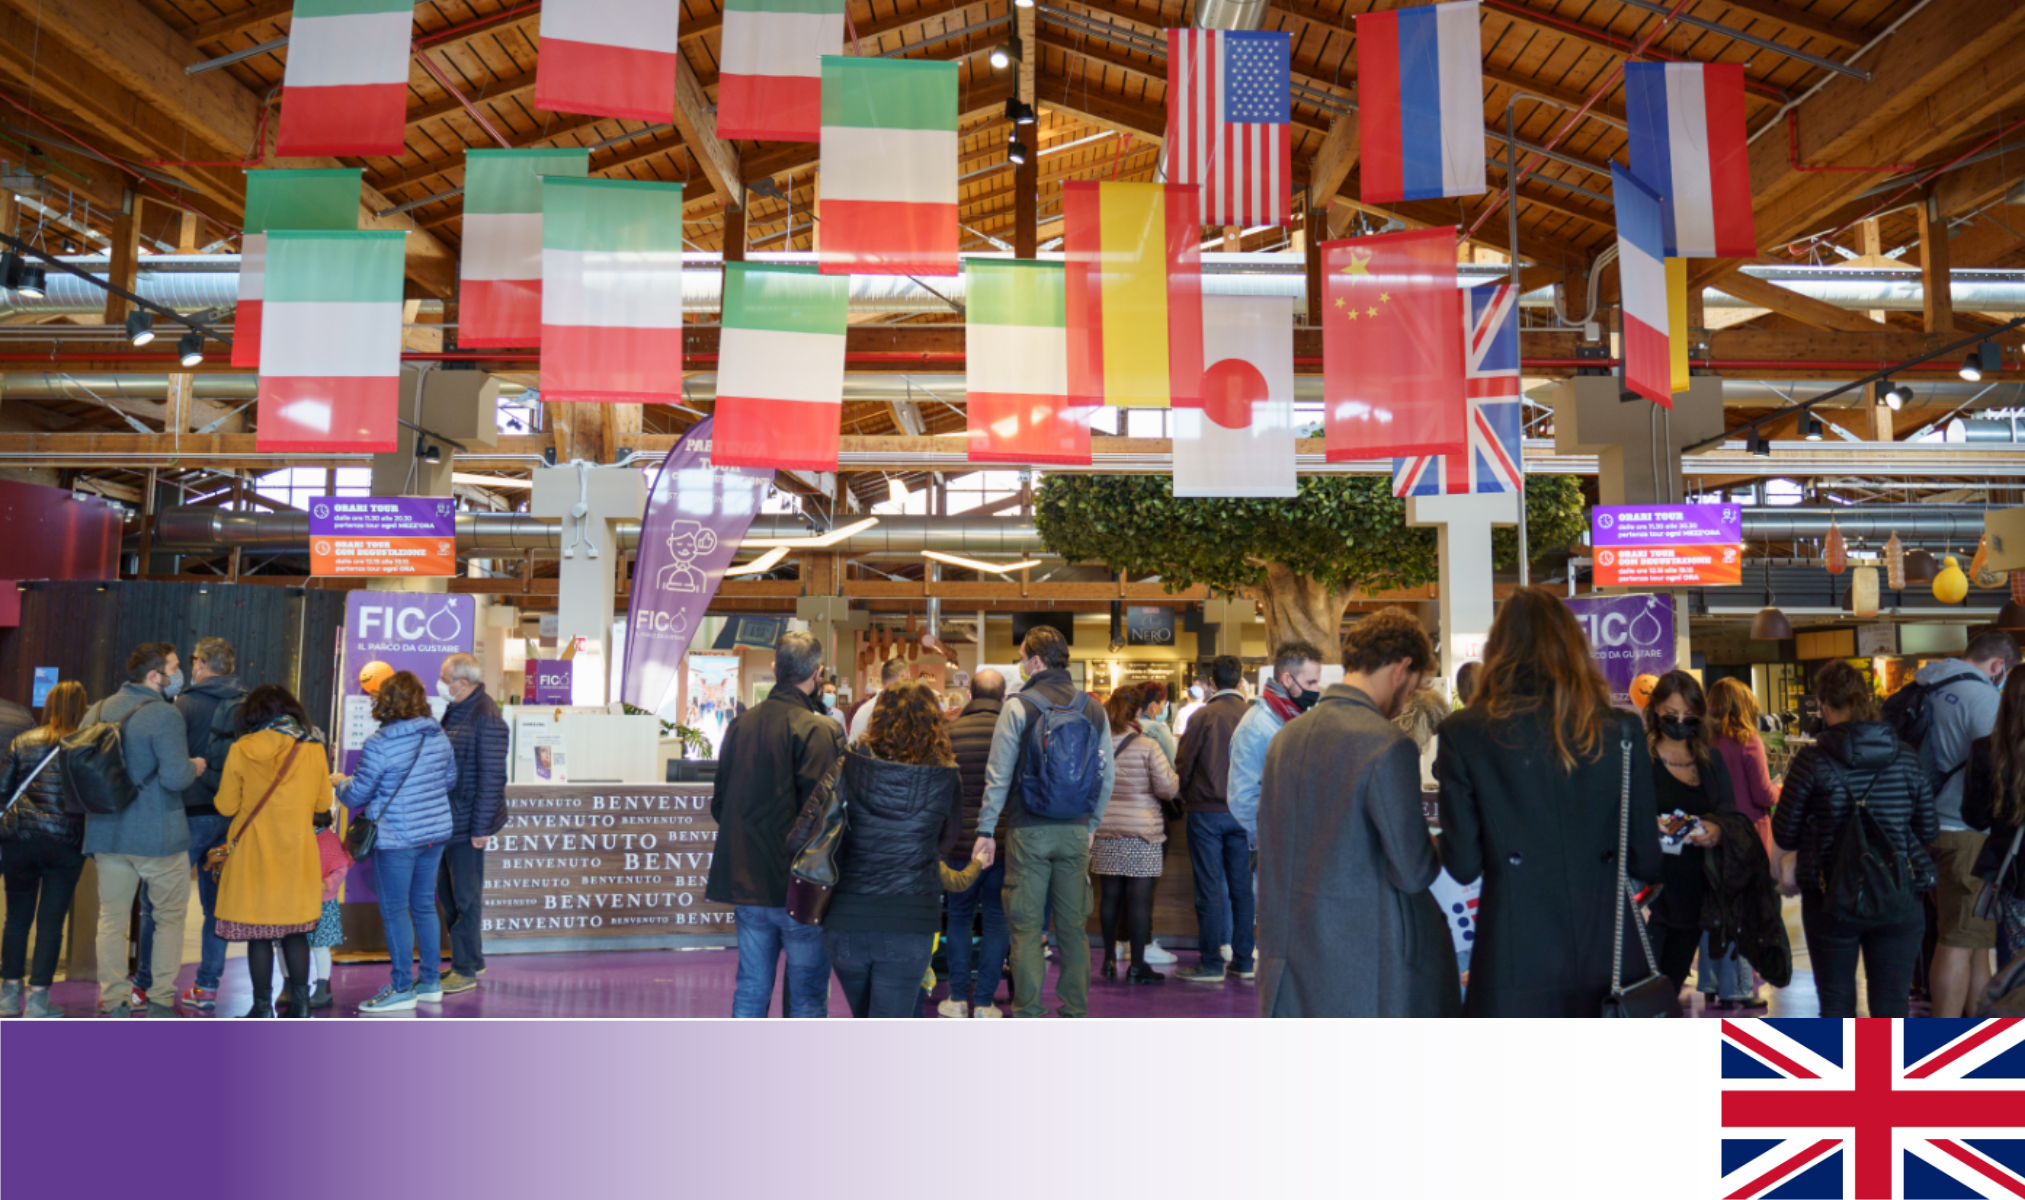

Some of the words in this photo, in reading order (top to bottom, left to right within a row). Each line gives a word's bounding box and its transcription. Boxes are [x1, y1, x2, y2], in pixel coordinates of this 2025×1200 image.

[334, 504, 368, 512] ORARI
[370, 504, 398, 512] TOUR
[1618, 512, 1652, 521] ORARI
[1654, 512, 1684, 520] TOUR
[1640, 557, 1712, 565] DEGUSTAZIONE
[368, 643, 400, 652] PARCO
[402, 644, 416, 652] DA
[418, 644, 460, 653] GUSTARE
[1609, 650, 1620, 659] DA
[504, 814, 615, 828] ENVENUTO
[621, 816, 693, 824] BENVENUTO
[484, 833, 657, 851] BENVENUTO
[668, 831, 718, 841] BENVE
[502, 858, 601, 869] BENVENUTO
[624, 852, 714, 870] BENV
[484, 878, 570, 888] BENVENUTO
[582, 875, 662, 884] BENVENUTO
[675, 876, 708, 887] BEN
[544, 892, 693, 909] BENVENUTO
[481, 915, 602, 931] BENVENUTO
[675, 912, 735, 924] BENVE
